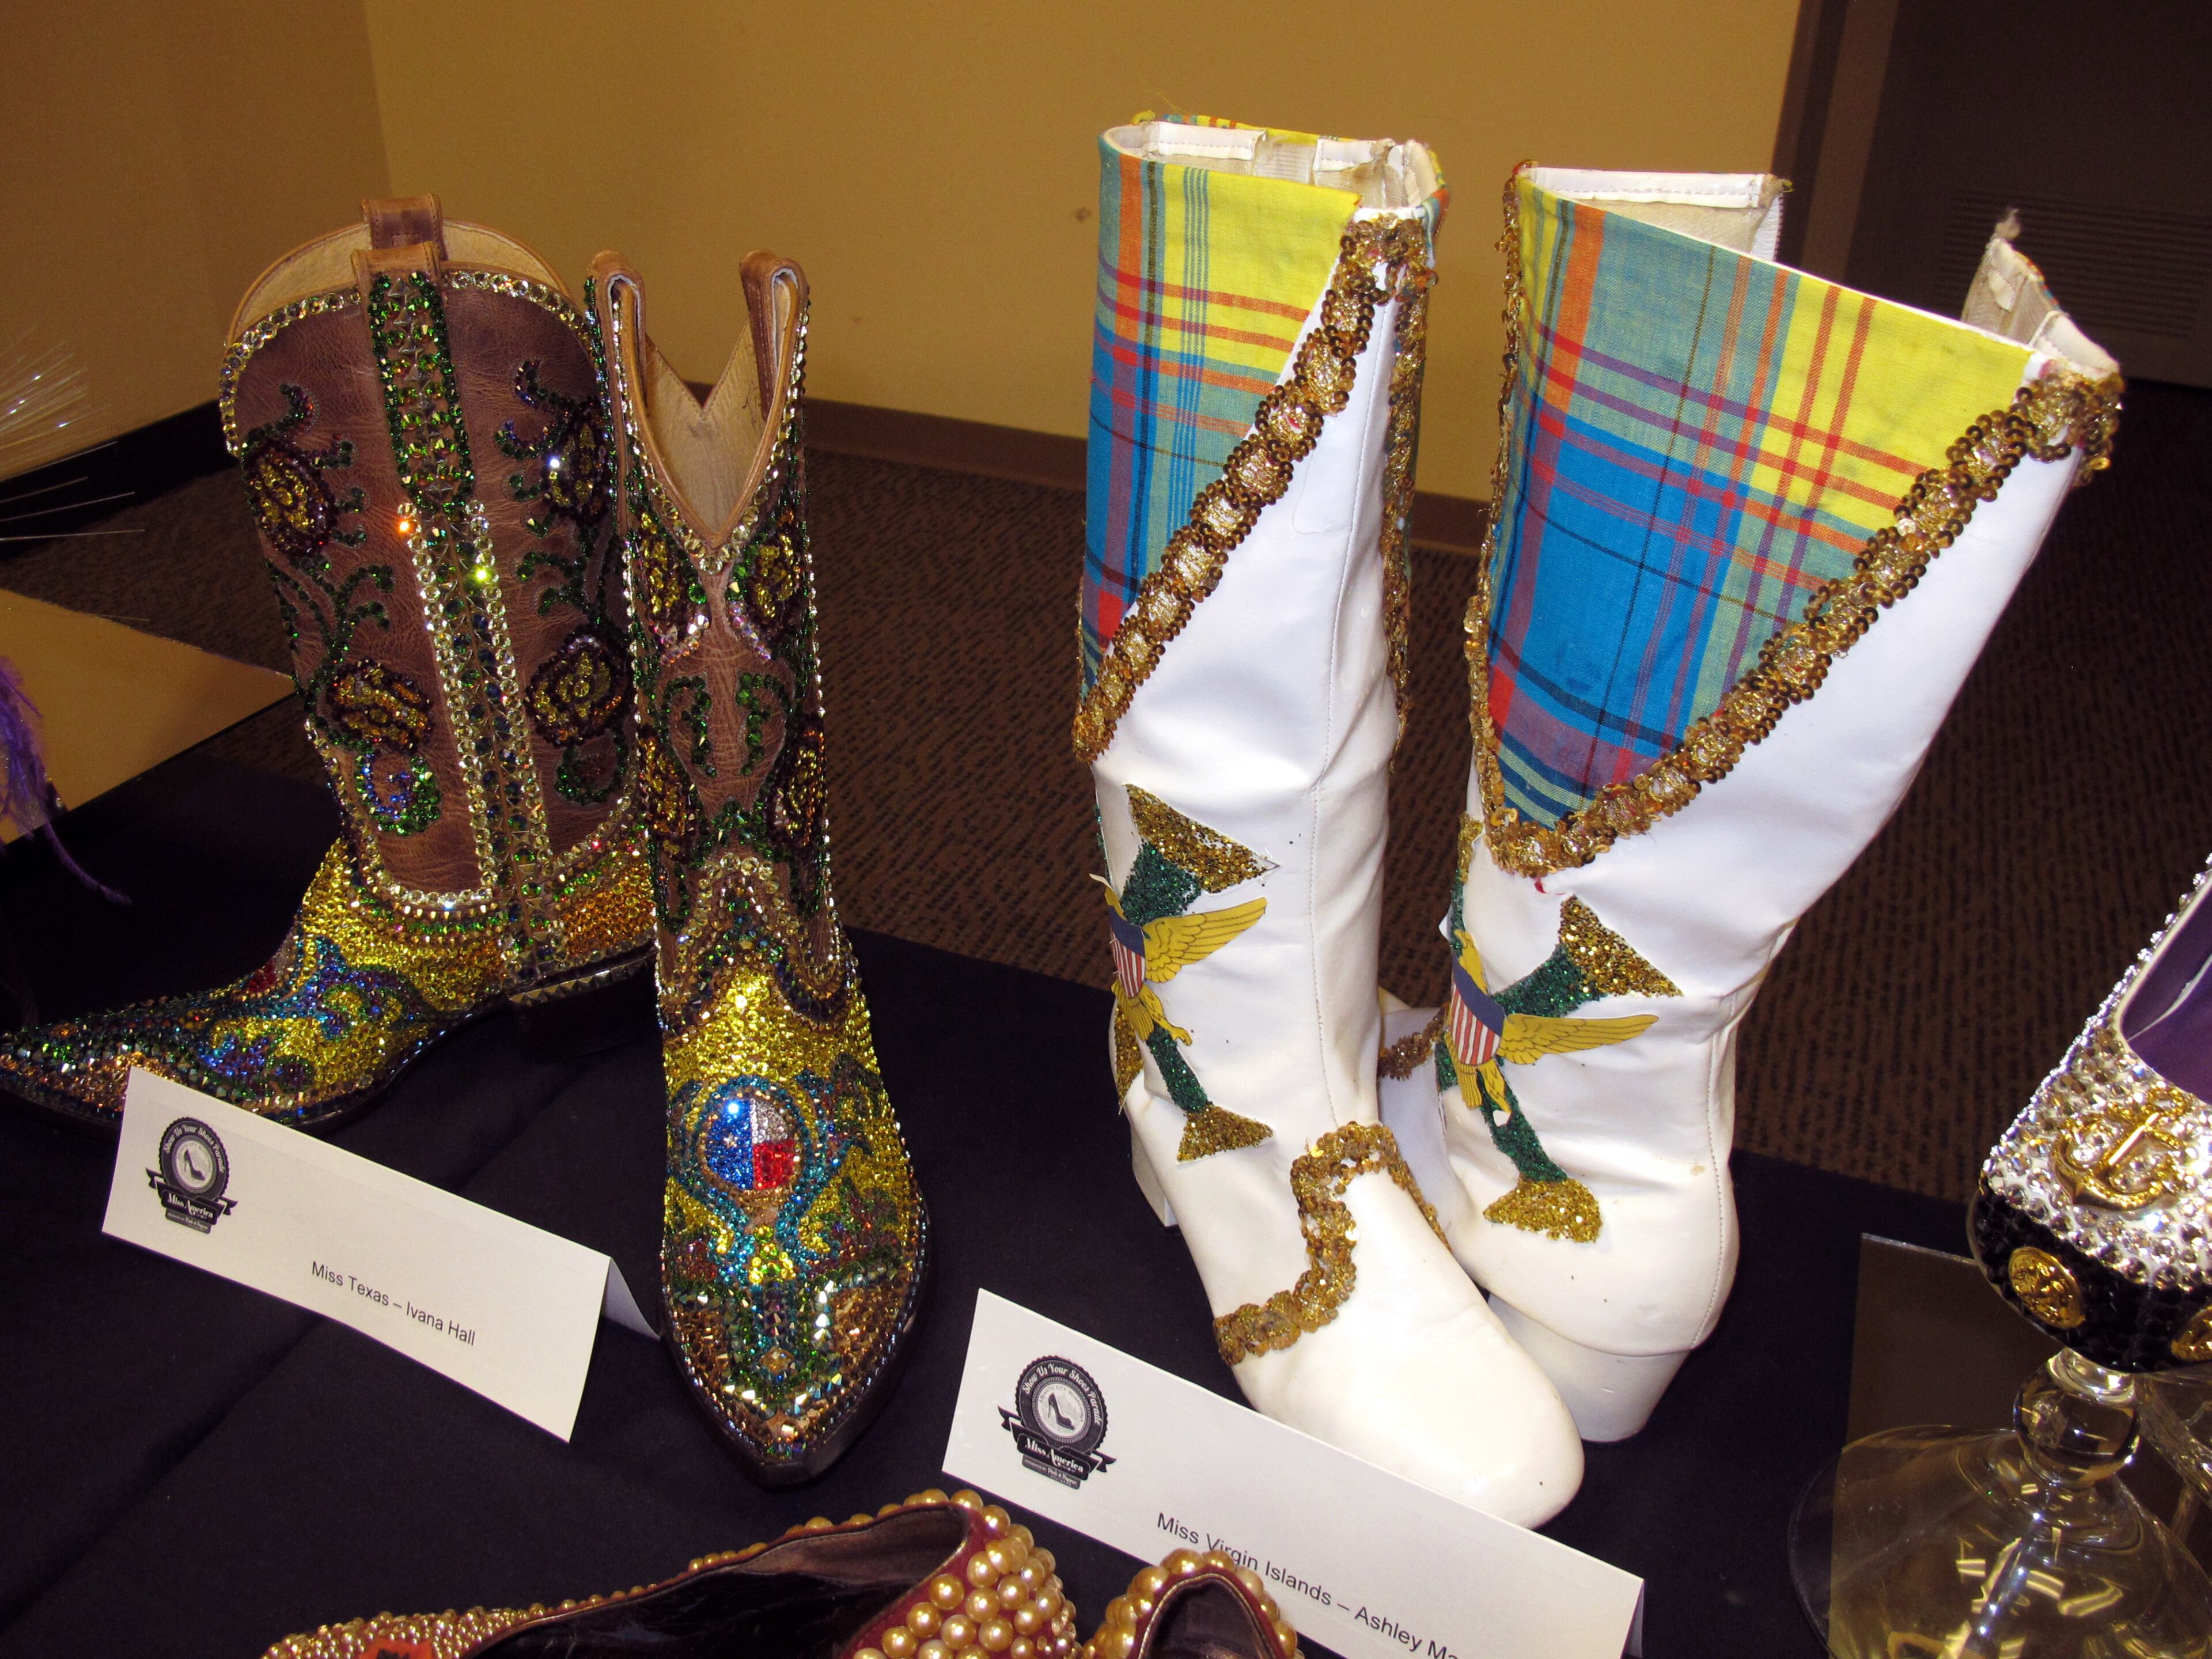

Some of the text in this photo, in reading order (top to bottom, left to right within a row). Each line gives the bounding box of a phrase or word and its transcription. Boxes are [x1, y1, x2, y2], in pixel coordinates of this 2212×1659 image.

[164, 1134, 175, 1153] Show
[174, 1126, 183, 1137] Us
[182, 1124, 197, 1133] Your
[198, 1127, 213, 1146] Shoes
[167, 1192, 213, 1218] Miss America
[312, 1261, 343, 1286] Miss
[348, 1275, 389, 1306] Texas
[406, 1301, 443, 1331] Ivana
[448, 1320, 476, 1346] Hall
[1022, 1363, 1103, 1425] Show Us Your Shoes Parade
[1025, 1437, 1046, 1457] Miss
[1046, 1448, 1084, 1473] America
[1157, 1512, 1199, 1544] Miss
[1206, 1533, 1258, 1571] Virgin
[1266, 1560, 1332, 1605] Islands
[1354, 1606, 1422, 1652] Ashley
